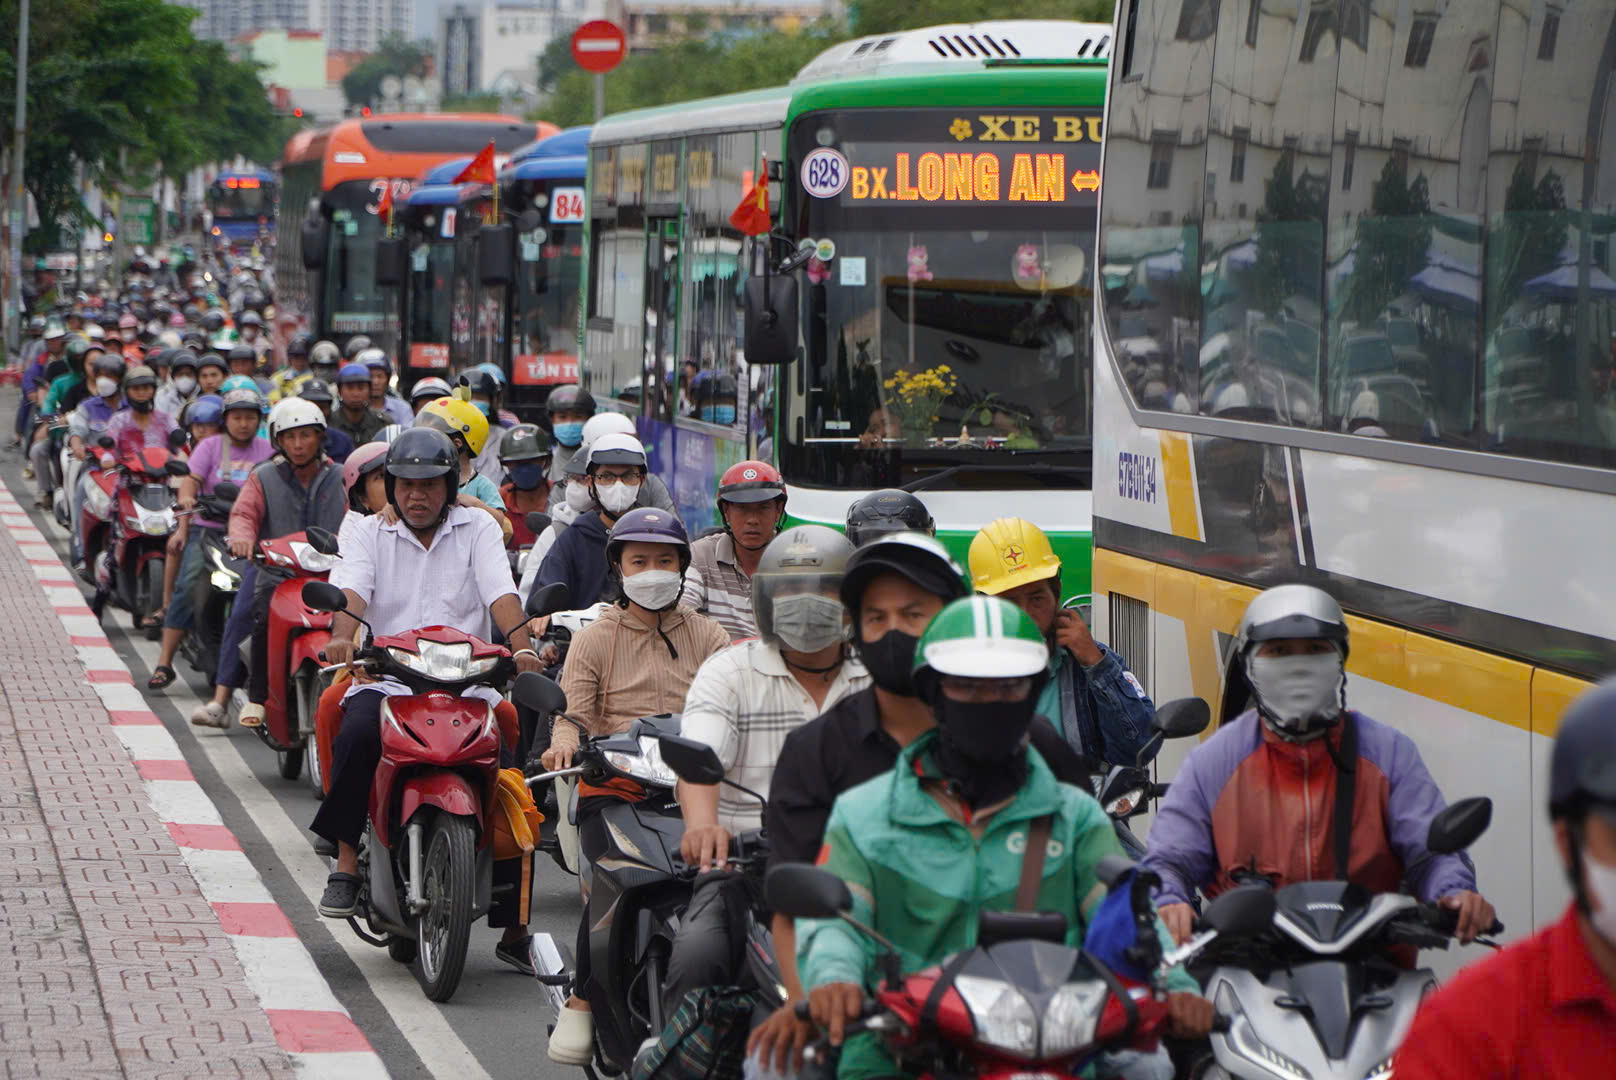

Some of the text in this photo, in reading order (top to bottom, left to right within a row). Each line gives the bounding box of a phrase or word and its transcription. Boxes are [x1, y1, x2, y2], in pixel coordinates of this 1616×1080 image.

[978, 116, 1040, 142] XE
[809, 158, 840, 188] 628
[1008, 153, 1065, 202] AN
[556, 194, 584, 219] 84
